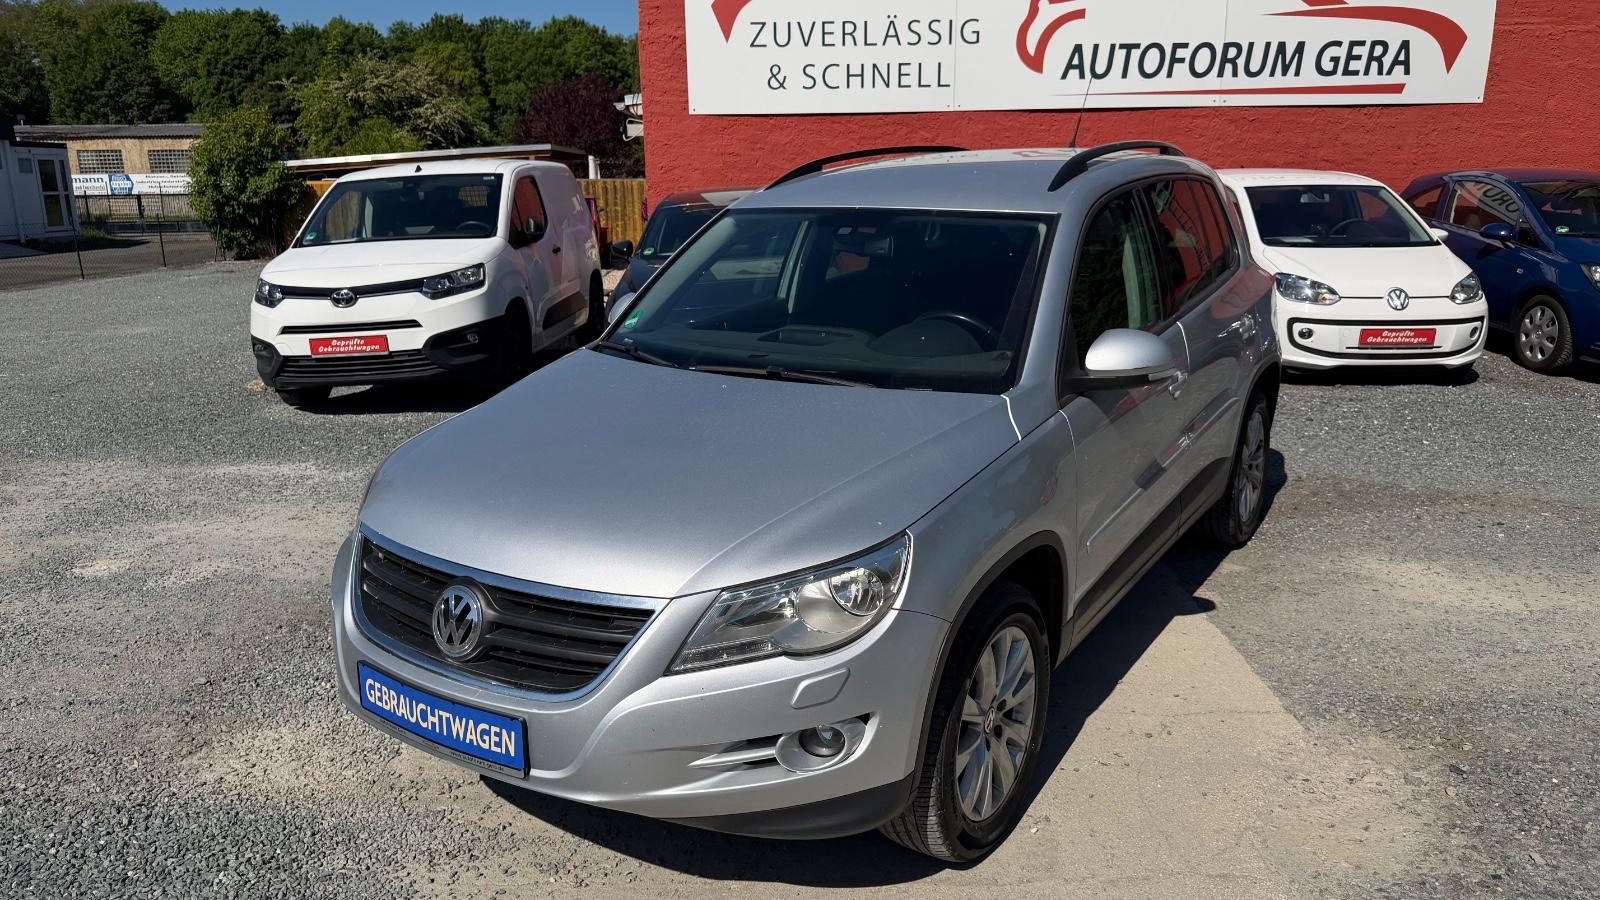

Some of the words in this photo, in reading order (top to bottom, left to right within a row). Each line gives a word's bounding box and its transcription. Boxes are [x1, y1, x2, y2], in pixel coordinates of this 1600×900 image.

[750, 15, 980, 48] ZUVERLÄSSIG
[1061, 41, 1306, 80] AUTOFORUM
[1314, 39, 1411, 77] GERA
[768, 65, 787, 90] &
[802, 62, 951, 91] SCHNELL
[331, 338, 365, 346] Geprüfte
[1366, 335, 1427, 344] Gebrauchtwagen
[1382, 330, 1415, 338] Geprüfte
[318, 344, 380, 352] Gebrauchtwagen
[365, 678, 515, 757] GEBRAUCHTWAGEN
